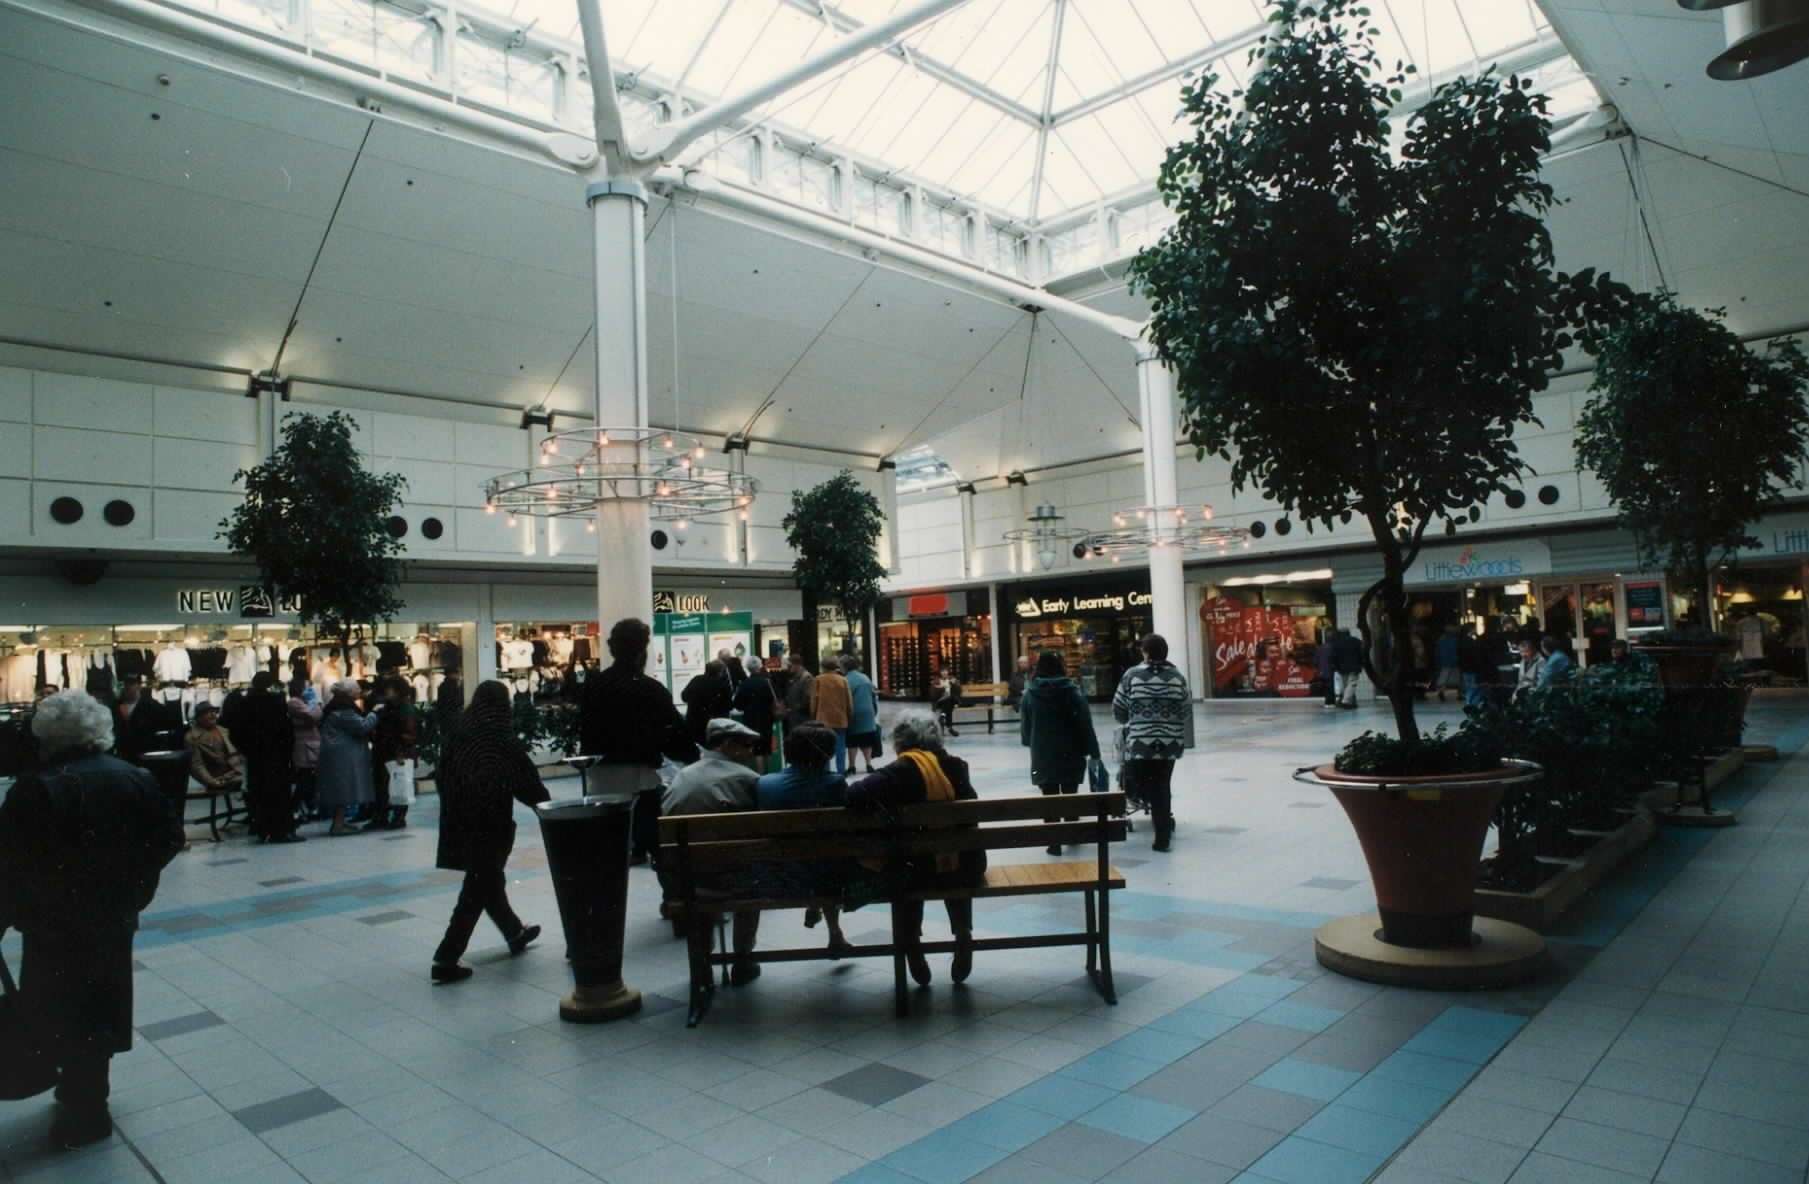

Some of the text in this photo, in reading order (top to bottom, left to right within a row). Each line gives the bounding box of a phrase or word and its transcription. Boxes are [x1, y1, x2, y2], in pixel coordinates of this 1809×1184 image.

[1425, 556, 1521, 581] Littlewoods
[178, 591, 304, 613] NEW LO
[676, 594, 711, 613] LOOK
[1042, 591, 1153, 614] Early Learning Cen
[1216, 636, 1245, 671] Sale
